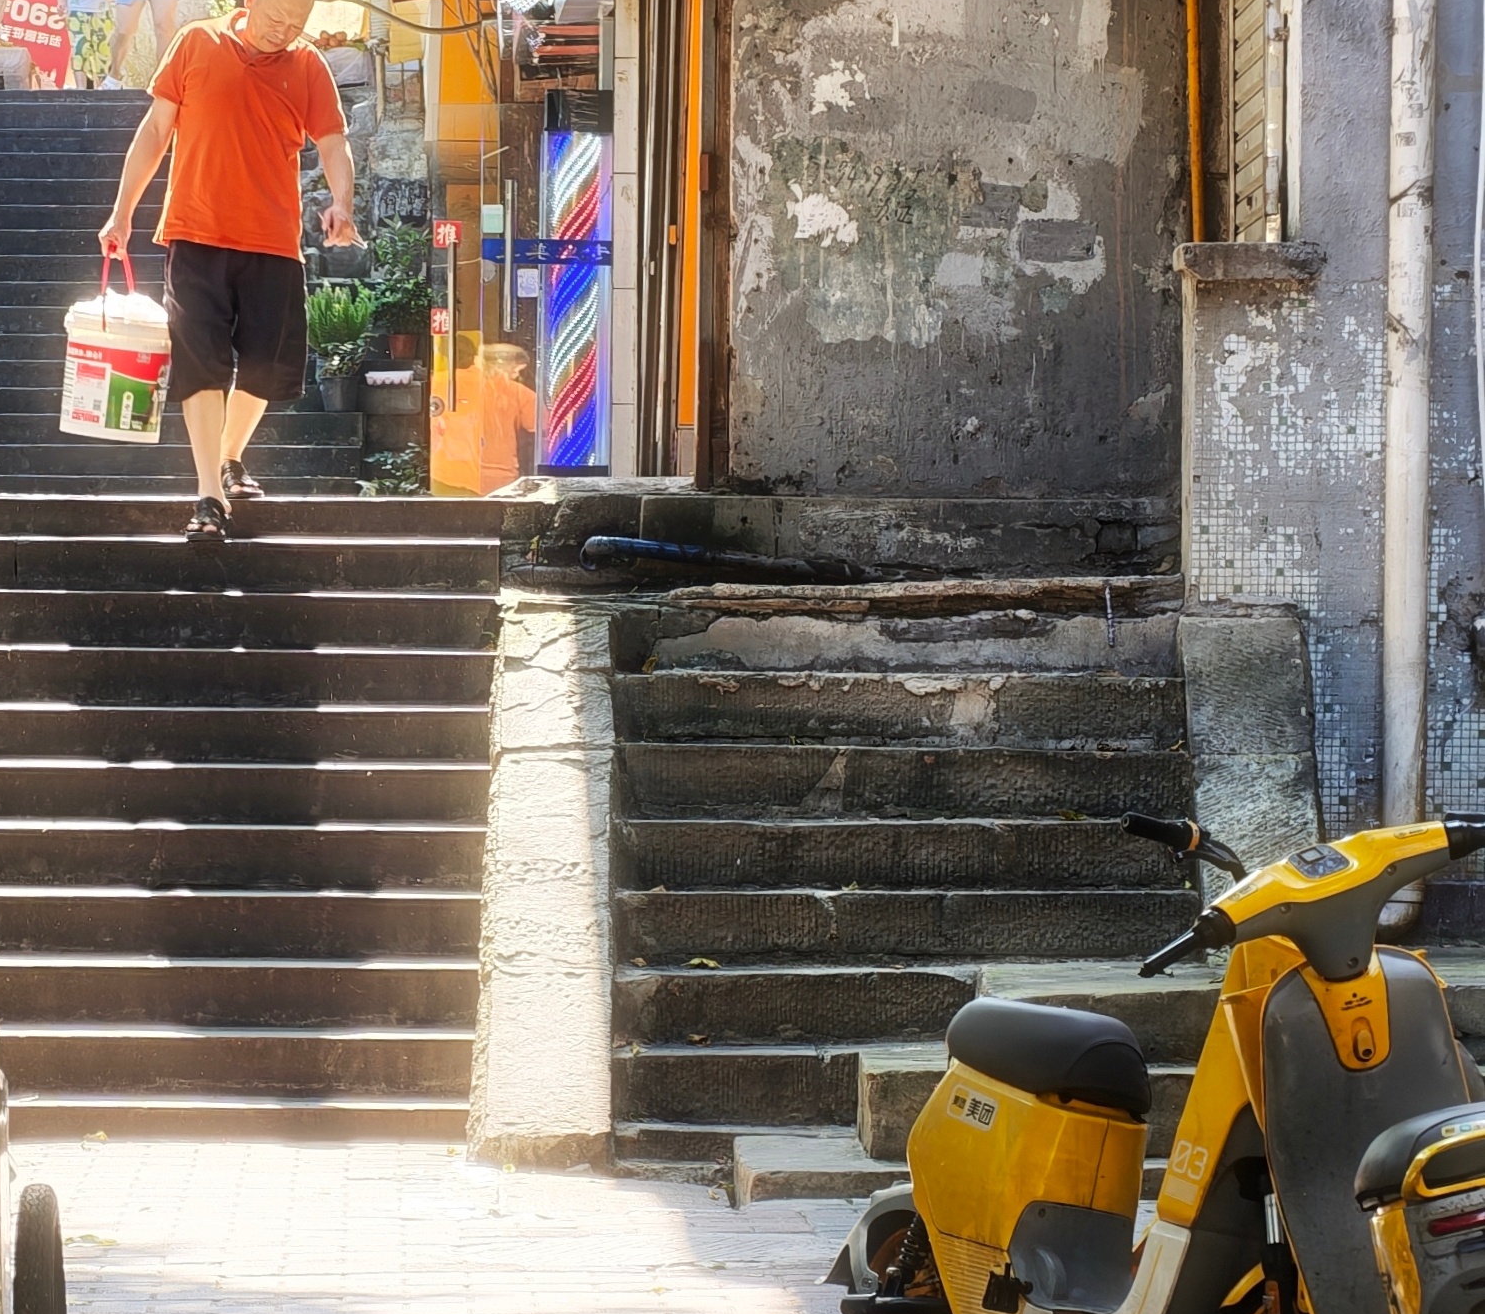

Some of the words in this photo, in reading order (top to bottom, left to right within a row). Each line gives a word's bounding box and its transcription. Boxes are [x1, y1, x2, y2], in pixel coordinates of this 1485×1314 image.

[436, 223, 459, 245] 推
[965, 1097, 995, 1126] 美团
[1172, 1140, 1209, 1180] 03
